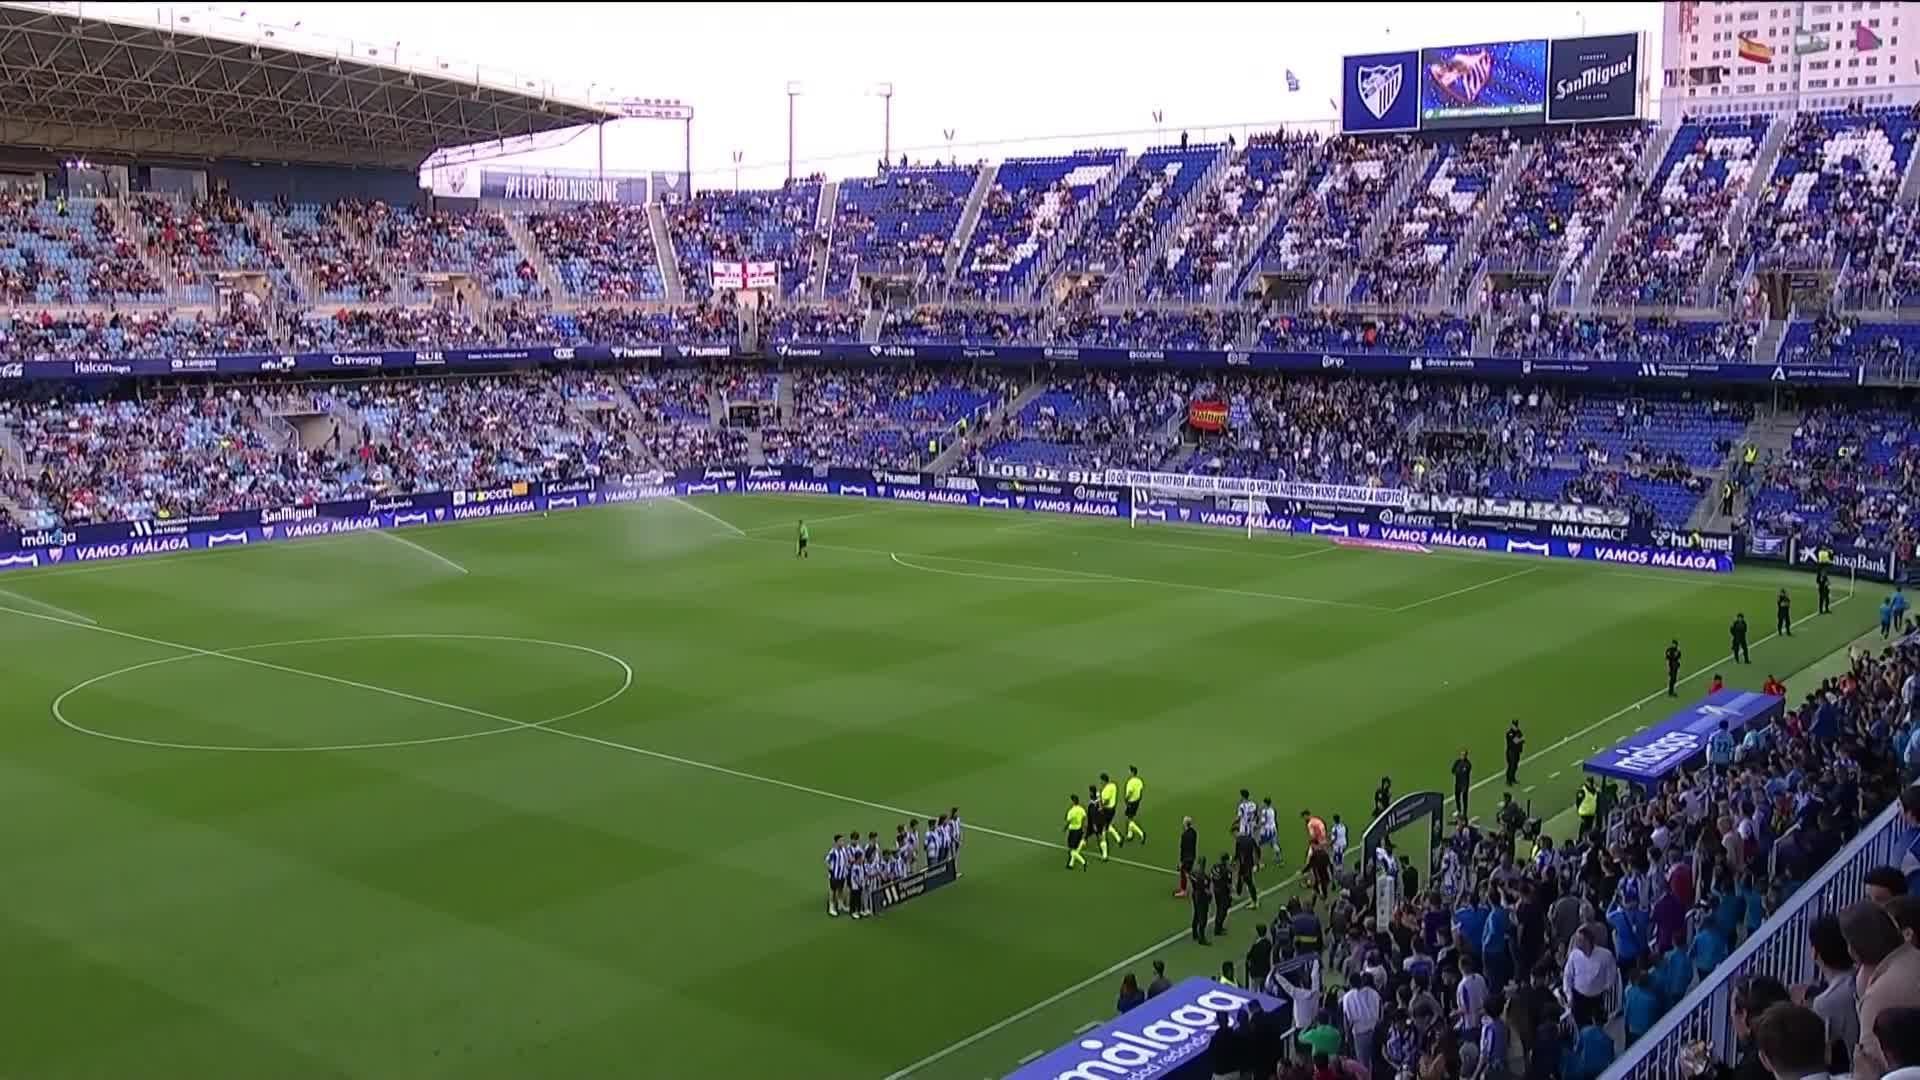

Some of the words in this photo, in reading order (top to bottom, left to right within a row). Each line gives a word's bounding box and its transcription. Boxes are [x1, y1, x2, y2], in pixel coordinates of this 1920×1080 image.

[1555, 54, 1632, 99] SanMiguel
[624, 345, 661, 357] hummel
[691, 345, 730, 356] hummel
[884, 347, 915, 357] vithas
[746, 481, 787, 492] VAMOS
[788, 480, 828, 493] MÁLAGA
[884, 471, 920, 486] hummel
[893, 488, 926, 501] VAMOS
[927, 490, 968, 504] MÁLAGA
[261, 506, 317, 524] SanMiguel
[453, 505, 491, 520] VAMOS
[493, 500, 535, 516] MÁLAGA
[1033, 500, 1071, 513] VAMOS
[1073, 501, 1118, 516] MÁLAGA
[285, 522, 328, 538] VAMOS
[331, 517, 380, 533] MÁLAGA
[1200, 512, 1242, 526] VAMOS
[1381, 527, 1428, 543] VAMOS
[1431, 529, 1488, 549] MÁLAGA
[76, 542, 129, 560] VAMOS
[131, 537, 190, 556] MÁLAGA
[1594, 548, 1648, 564] VAMOS
[1651, 551, 1717, 570] MÁLAGA
[1830, 552, 1888, 574] aixaBank
